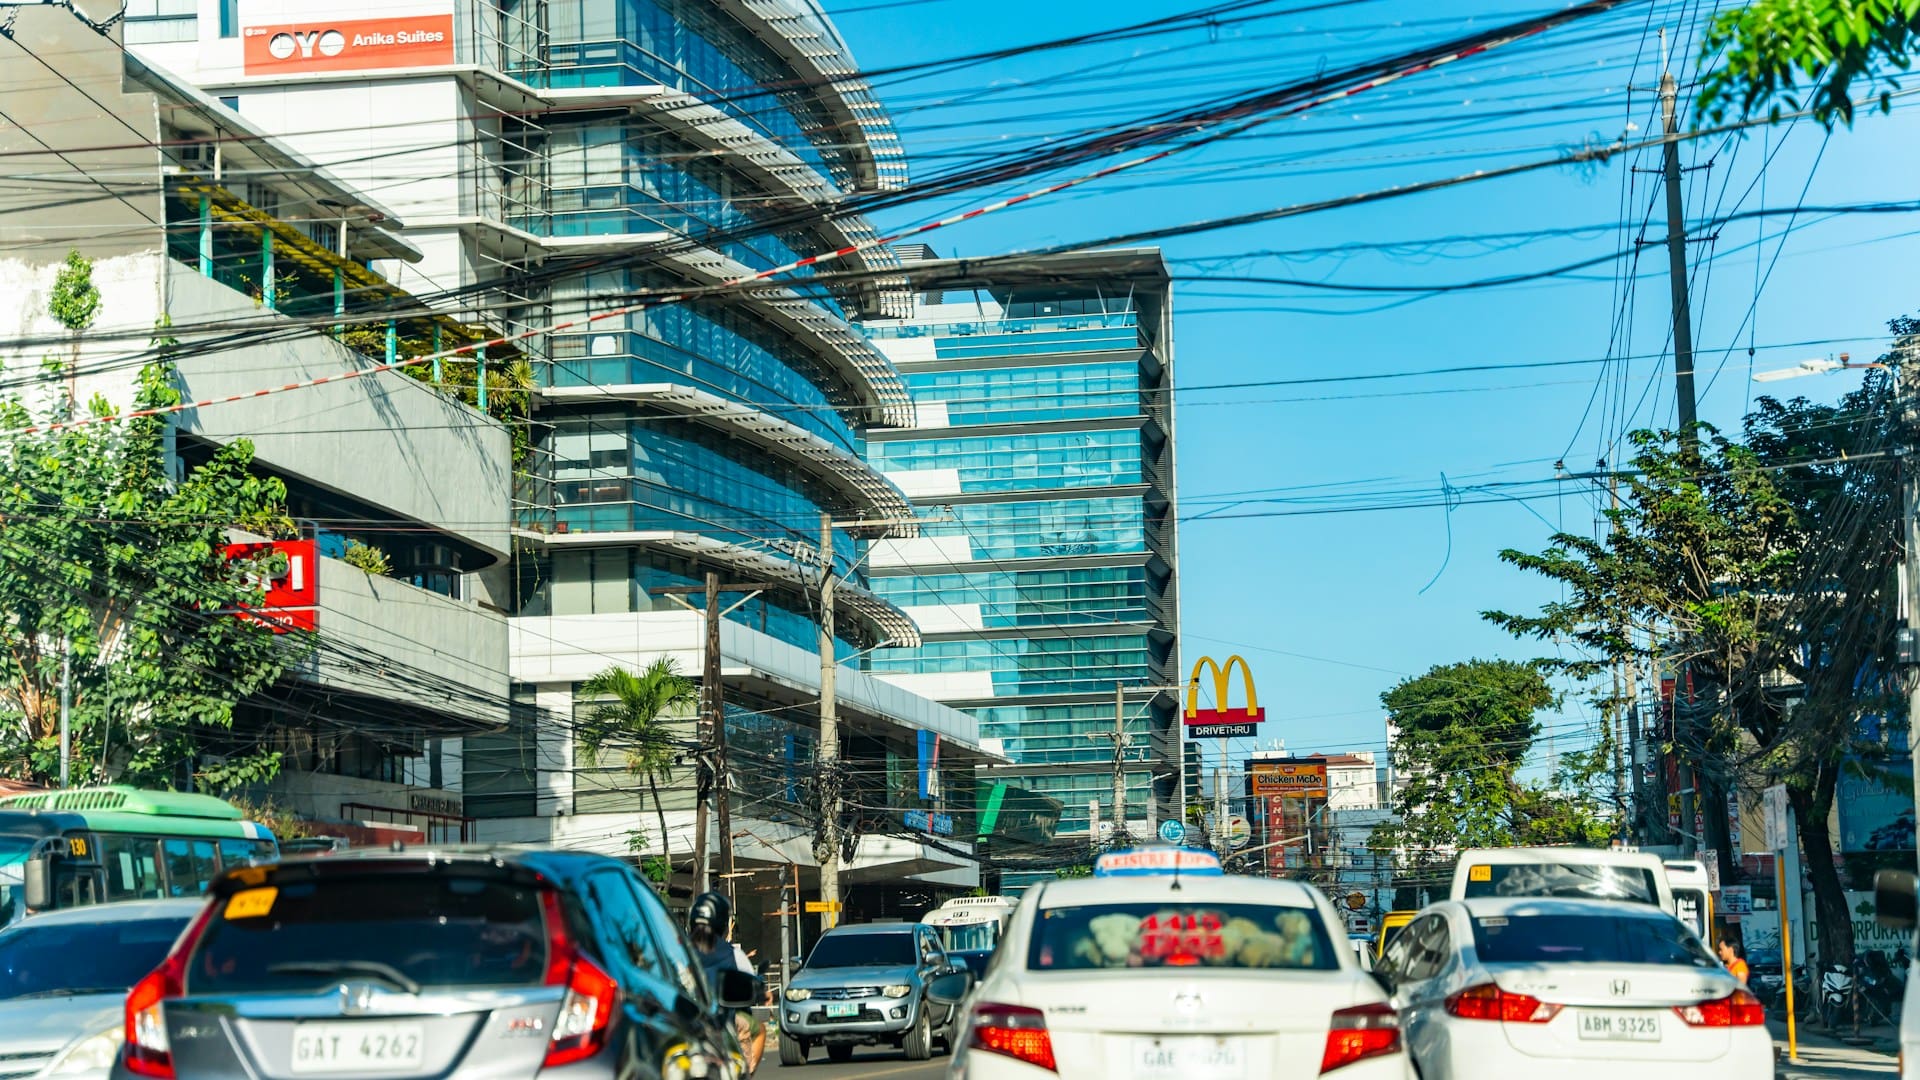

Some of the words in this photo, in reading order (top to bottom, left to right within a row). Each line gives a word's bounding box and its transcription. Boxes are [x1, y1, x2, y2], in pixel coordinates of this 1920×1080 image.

[269, 29, 345, 59] OYO
[353, 34, 394, 47] Anika
[397, 31, 444, 44] Suites
[1196, 725, 1250, 736] DRIVETHRU
[1257, 774, 1295, 784] Chicken
[1296, 774, 1322, 784] McDo
[70, 838, 86, 856] 130
[1584, 1017, 1613, 1032] ABM
[1618, 1018, 1656, 1034] 9325
[297, 1036, 340, 1060] GAT
[358, 1033, 419, 1057] 4262
